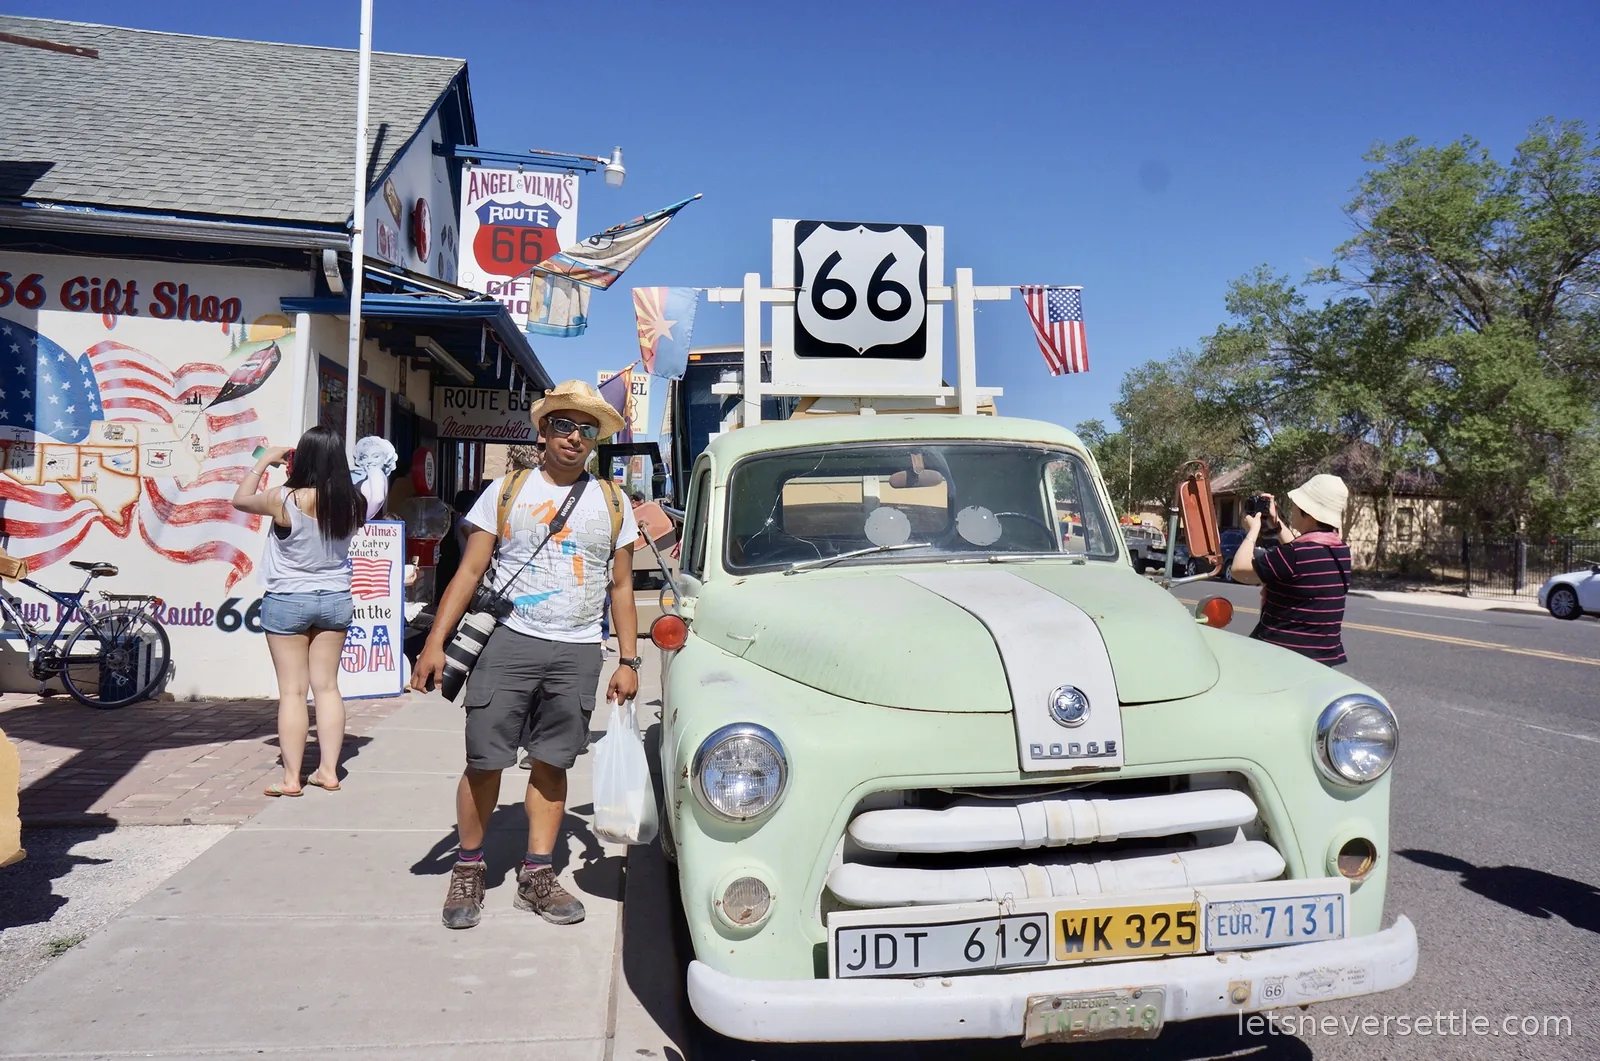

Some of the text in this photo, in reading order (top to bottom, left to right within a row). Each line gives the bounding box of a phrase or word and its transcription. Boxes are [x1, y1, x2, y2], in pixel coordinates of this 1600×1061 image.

[467, 171, 573, 209] ANGEL & VILMA'S
[488, 205, 549, 228] ROUTE
[491, 227, 544, 265] 66
[486, 280, 531, 296] GIF
[811, 250, 912, 322] 66
[60, 276, 139, 330] Gift
[149, 281, 242, 336] Shop
[444, 388, 532, 412] ROUTE 66
[442, 415, 532, 440] Memorabilia
[560, 496, 576, 517] Canon
[363, 525, 397, 537] Vilma's
[349, 549, 379, 557] oducts
[362, 540, 390, 550] Carry
[153, 596, 215, 628] Route
[353, 605, 392, 619] in the
[341, 625, 396, 673] SA
[1030, 741, 1117, 757] DODGE
[1062, 911, 1197, 954] WK 325
[1261, 903, 1335, 939] 7131
[846, 921, 1042, 971] JDT 619
[1265, 985, 1282, 998] 66
[1064, 999, 1109, 1010] ARIZONA
